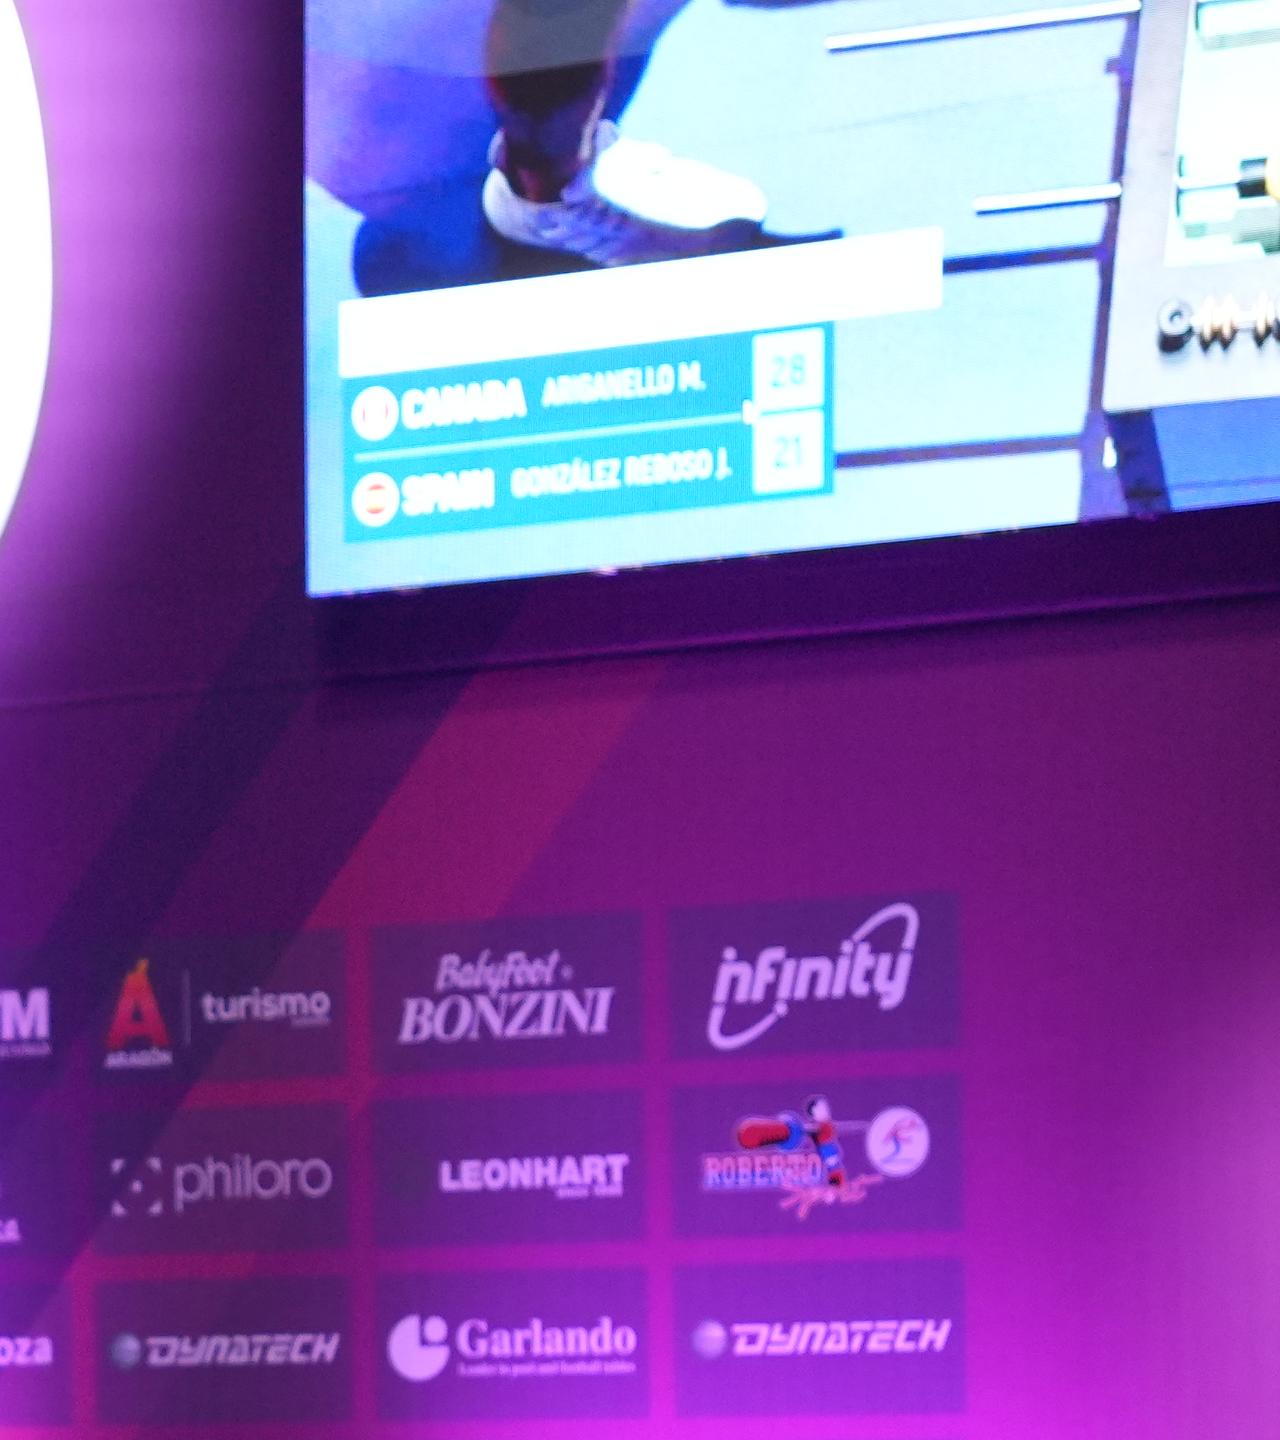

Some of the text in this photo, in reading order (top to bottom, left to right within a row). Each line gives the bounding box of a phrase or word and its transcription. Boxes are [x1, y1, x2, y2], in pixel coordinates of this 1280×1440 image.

[401, 467, 496, 516] SPAIN
[201, 986, 332, 1024] turismo
[397, 985, 616, 1045] BONZINI
[174, 1154, 333, 1213] philoro
[440, 1153, 630, 1193] LEONHART
[146, 1331, 340, 1368] DYNATECH
[455, 1316, 638, 1359] Garlando
[730, 1318, 953, 1356] DYNATECH
